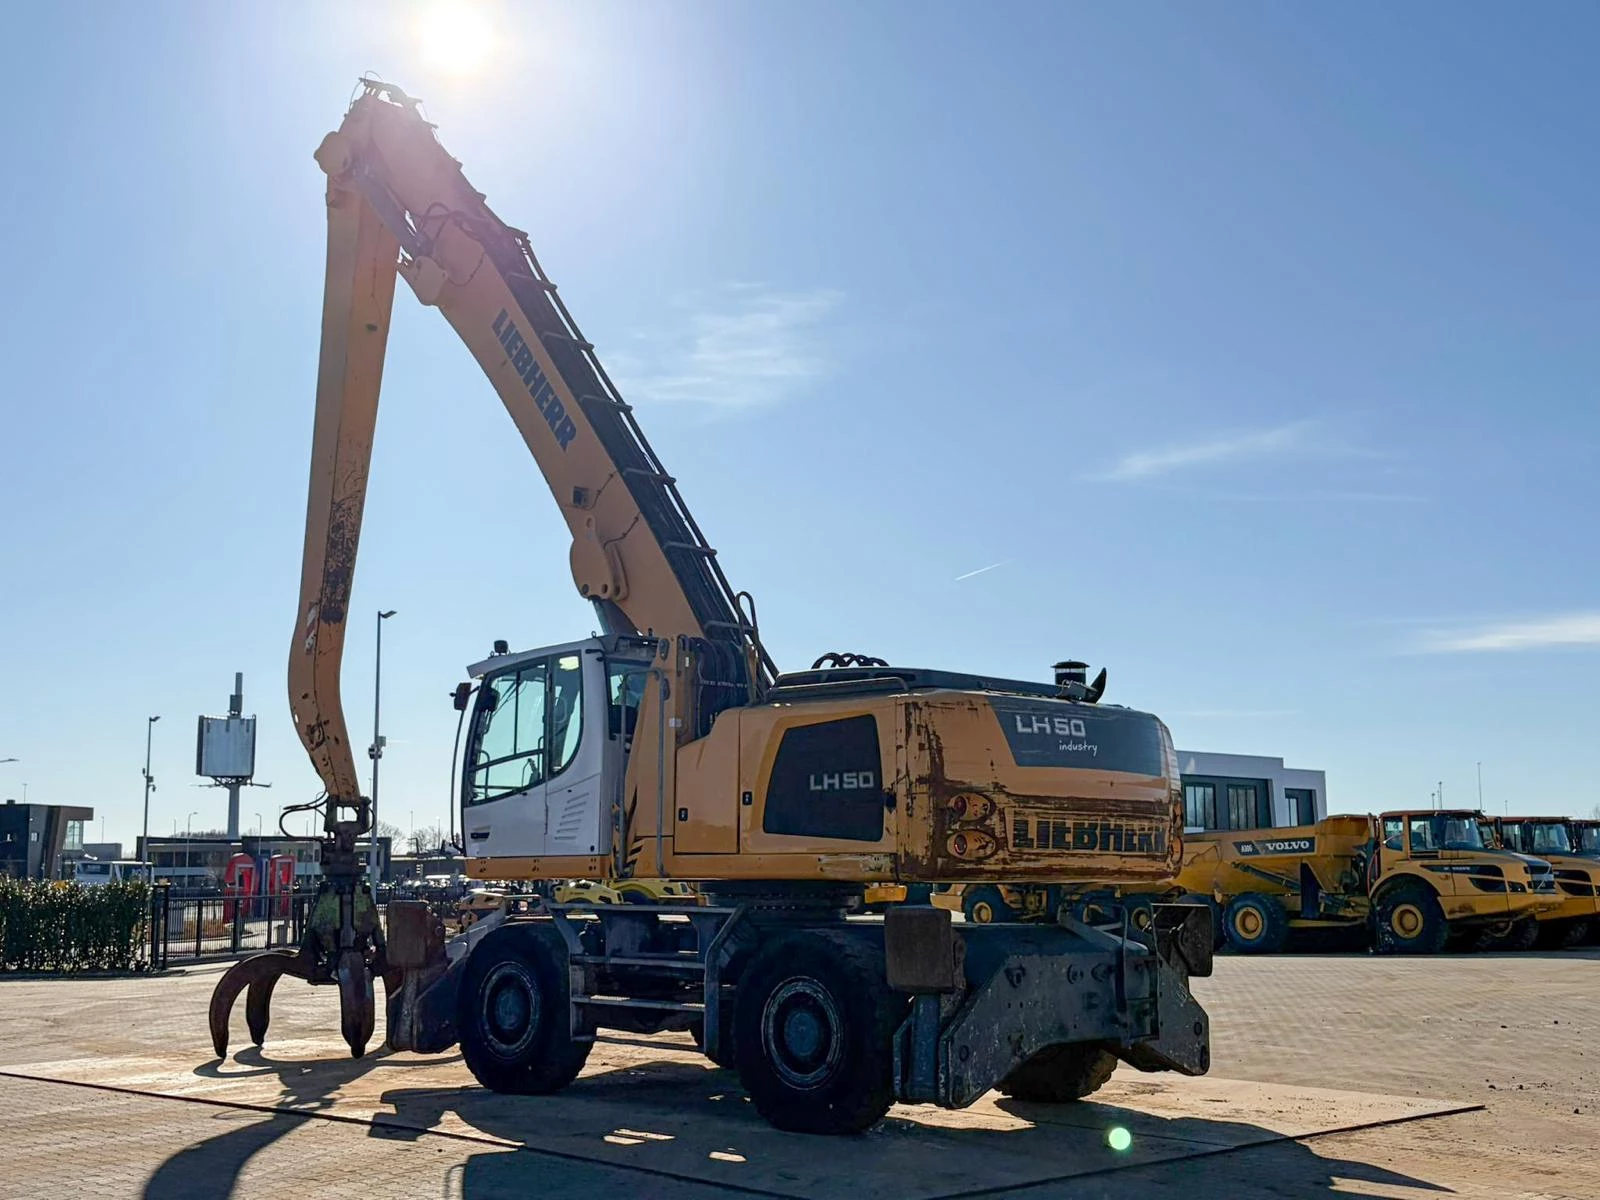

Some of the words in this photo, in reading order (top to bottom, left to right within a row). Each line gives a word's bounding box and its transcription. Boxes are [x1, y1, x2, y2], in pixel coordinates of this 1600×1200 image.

[491, 308, 577, 452] LIEBHERR
[1059, 740, 1098, 757] industry
[809, 771, 874, 791] LH50
[1266, 840, 1310, 851] VOLVO
